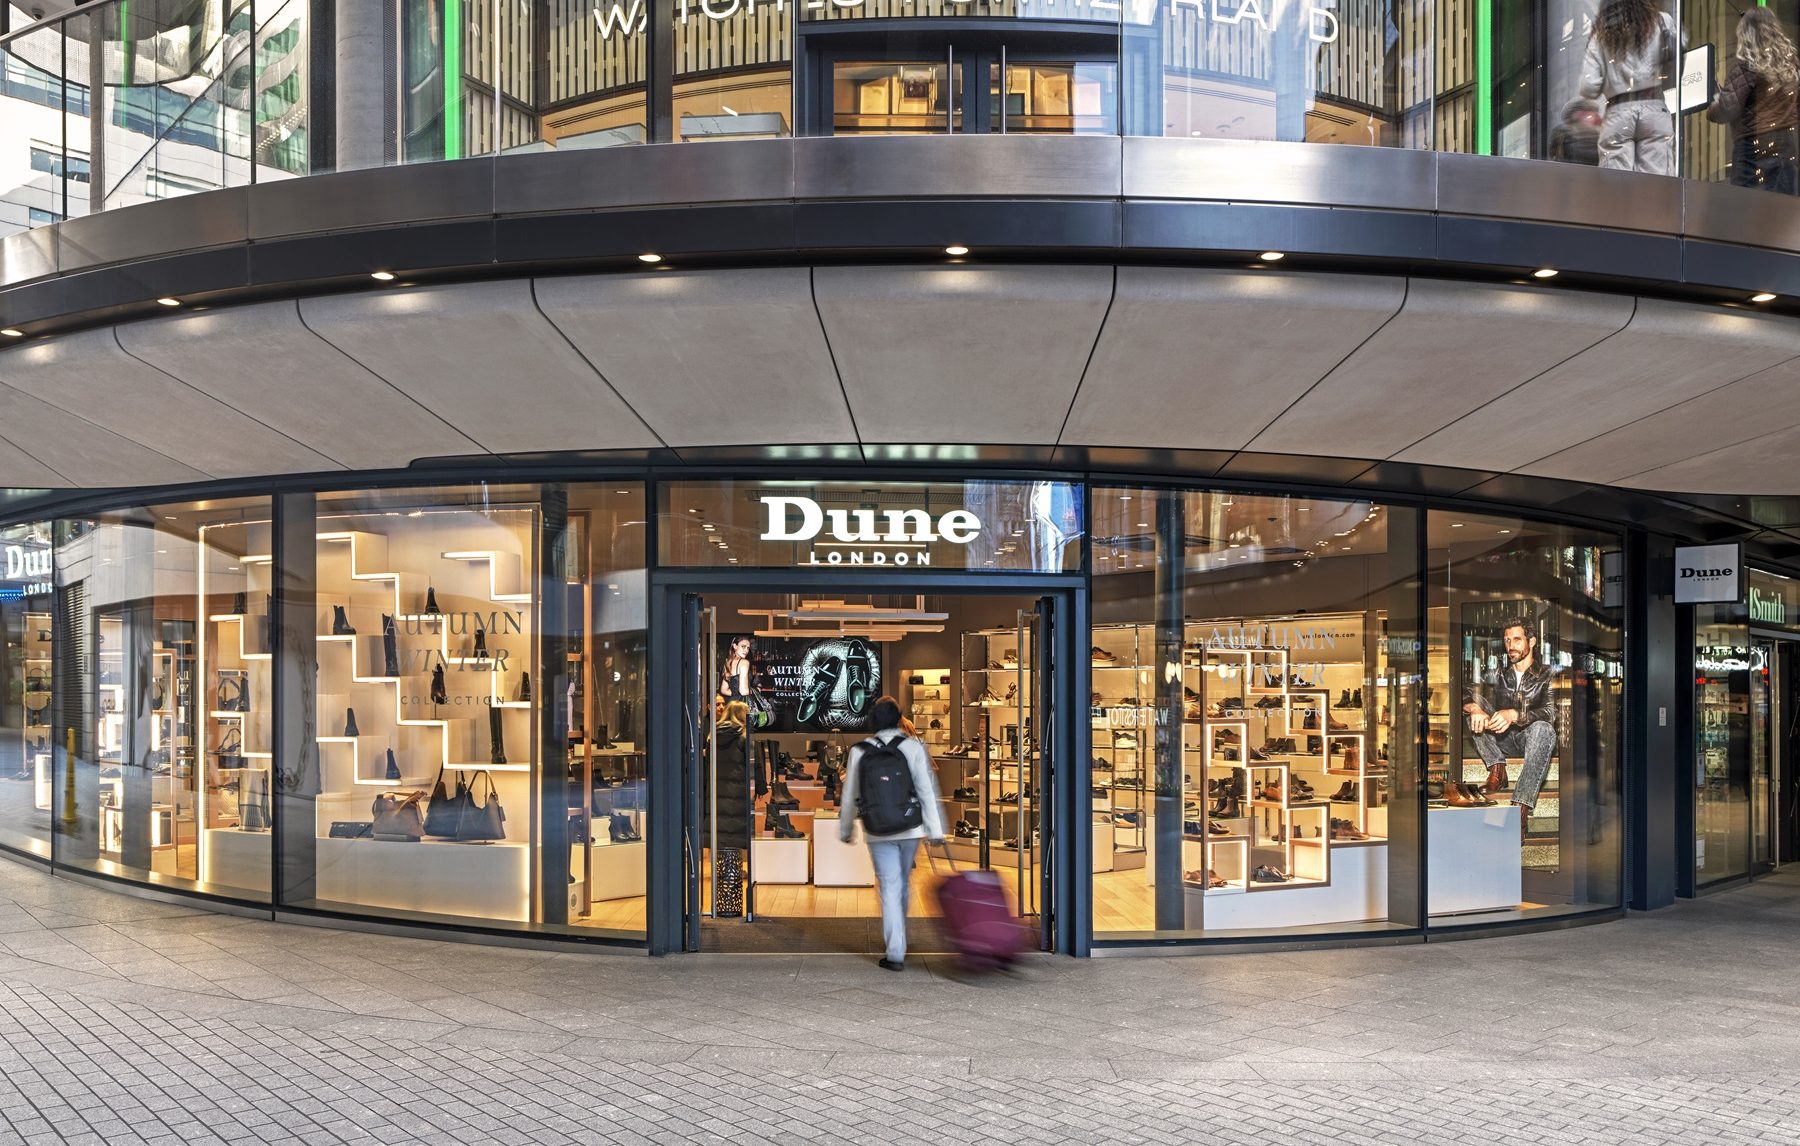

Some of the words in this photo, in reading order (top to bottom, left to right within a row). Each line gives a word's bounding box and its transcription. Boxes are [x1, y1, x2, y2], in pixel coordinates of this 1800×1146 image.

[760, 496, 981, 543] Dune
[5, 545, 52, 579] Dun
[811, 551, 931, 566] LONDON
[1680, 567, 1733, 578] Dune
[384, 611, 523, 635] AUTUMN
[1206, 627, 1336, 650] AUTUMN
[1216, 663, 1326, 686] WINTER
[400, 696, 505, 705] COLLECTION
